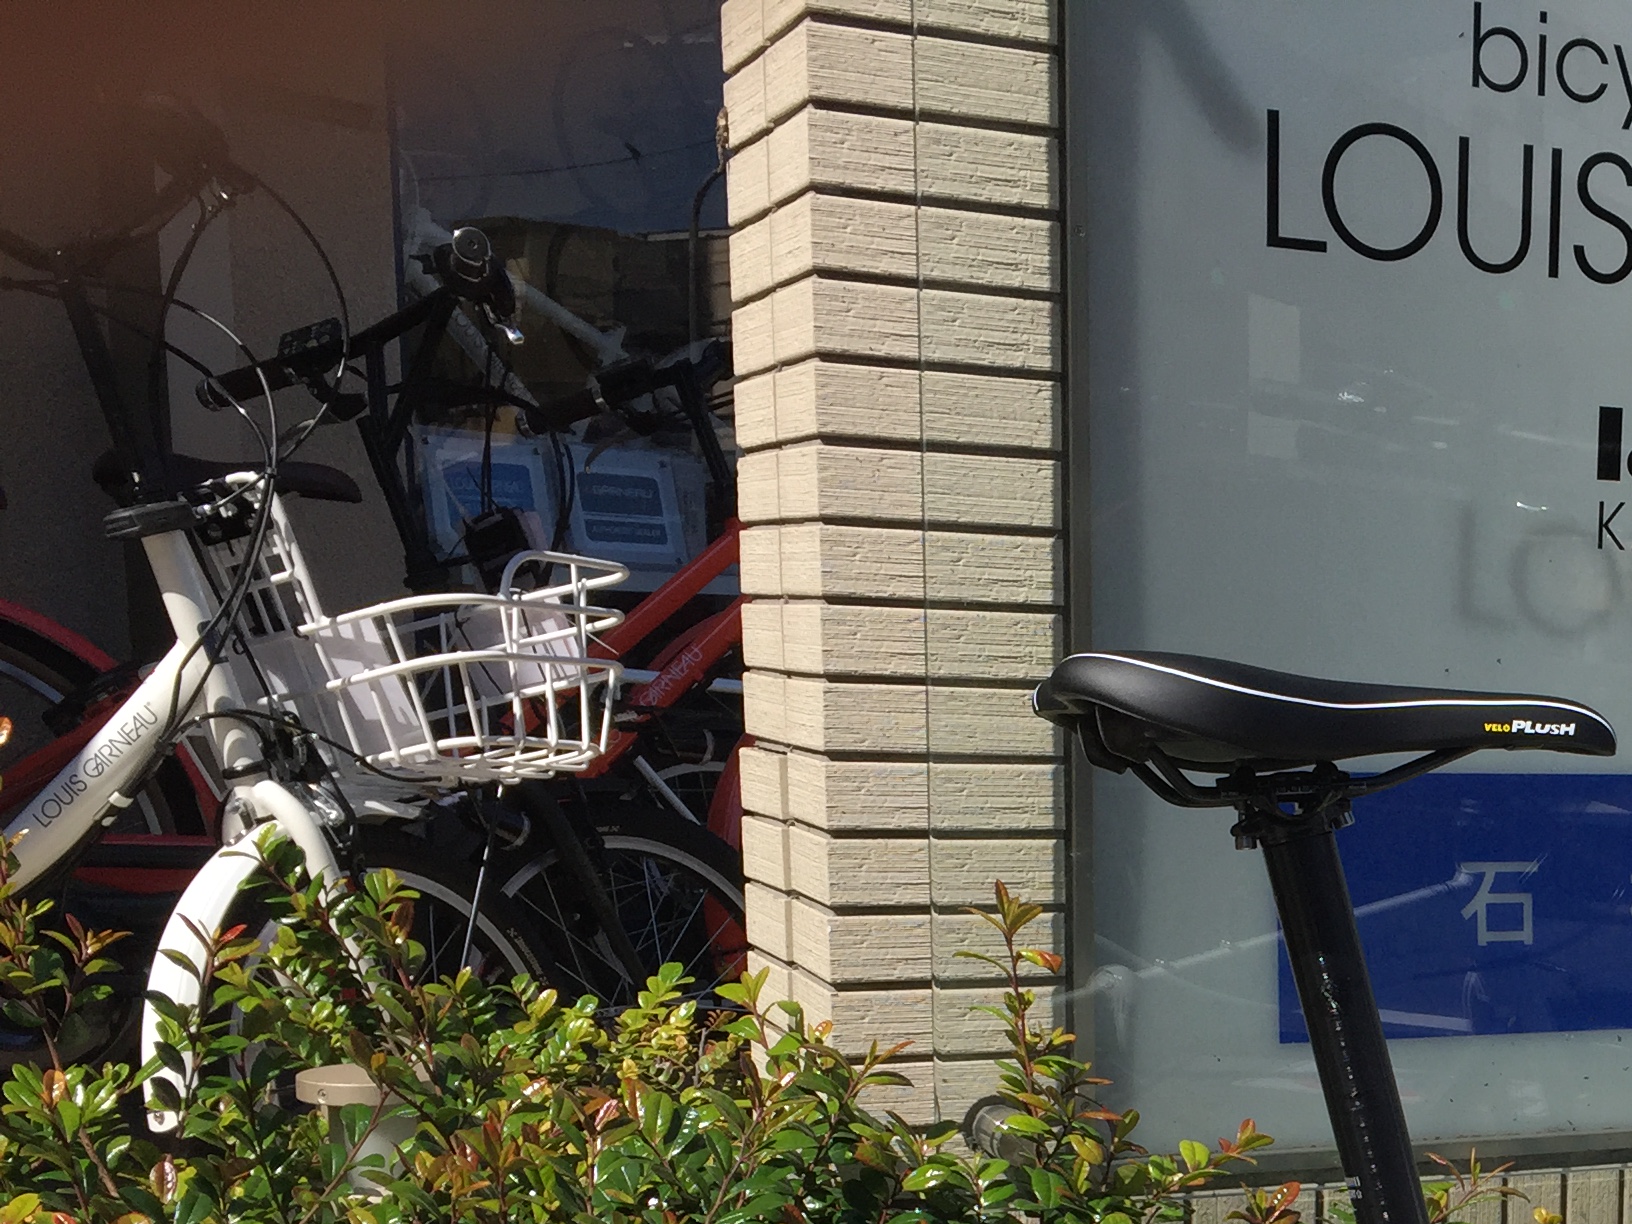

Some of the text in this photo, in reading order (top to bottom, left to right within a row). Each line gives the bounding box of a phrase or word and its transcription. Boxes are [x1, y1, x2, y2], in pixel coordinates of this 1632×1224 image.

[1484, 719, 1576, 736] VELO PLUSH
[32, 703, 158, 828] LOUIS GARNEAU
